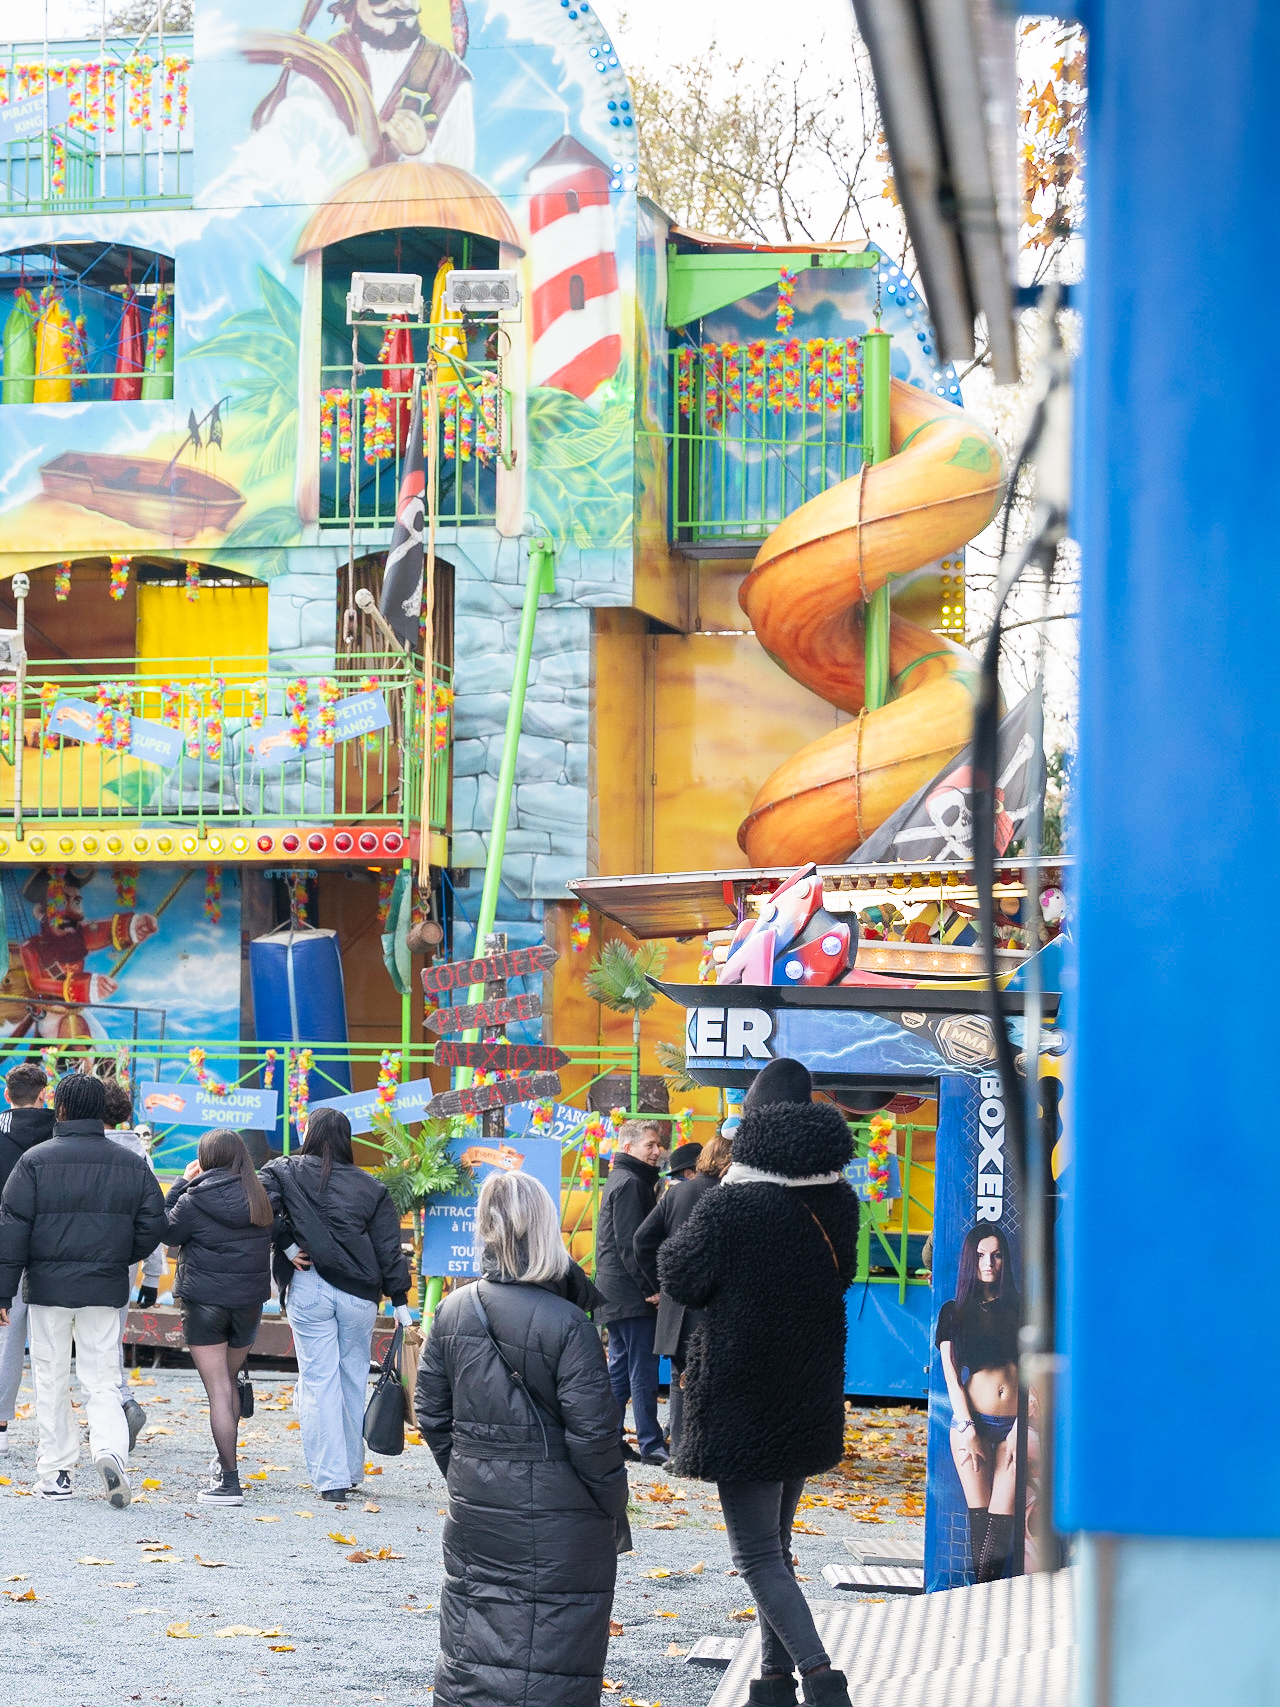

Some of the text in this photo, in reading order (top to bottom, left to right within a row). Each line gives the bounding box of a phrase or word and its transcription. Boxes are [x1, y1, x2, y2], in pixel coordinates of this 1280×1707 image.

[14, 114, 44, 134] KING
[133, 731, 172, 756] SUPER
[424, 947, 547, 993] COCOTIER
[436, 994, 531, 1034] PLAGE
[686, 1008, 773, 1058] ER
[950, 1026, 988, 1053] MMA
[195, 1092, 261, 1108] PARCOURS
[459, 1077, 538, 1114] BAR
[201, 1109, 253, 1123] SPORTIF
[976, 1077, 1005, 1222] BOXER
[448, 1261, 469, 1271] EST
